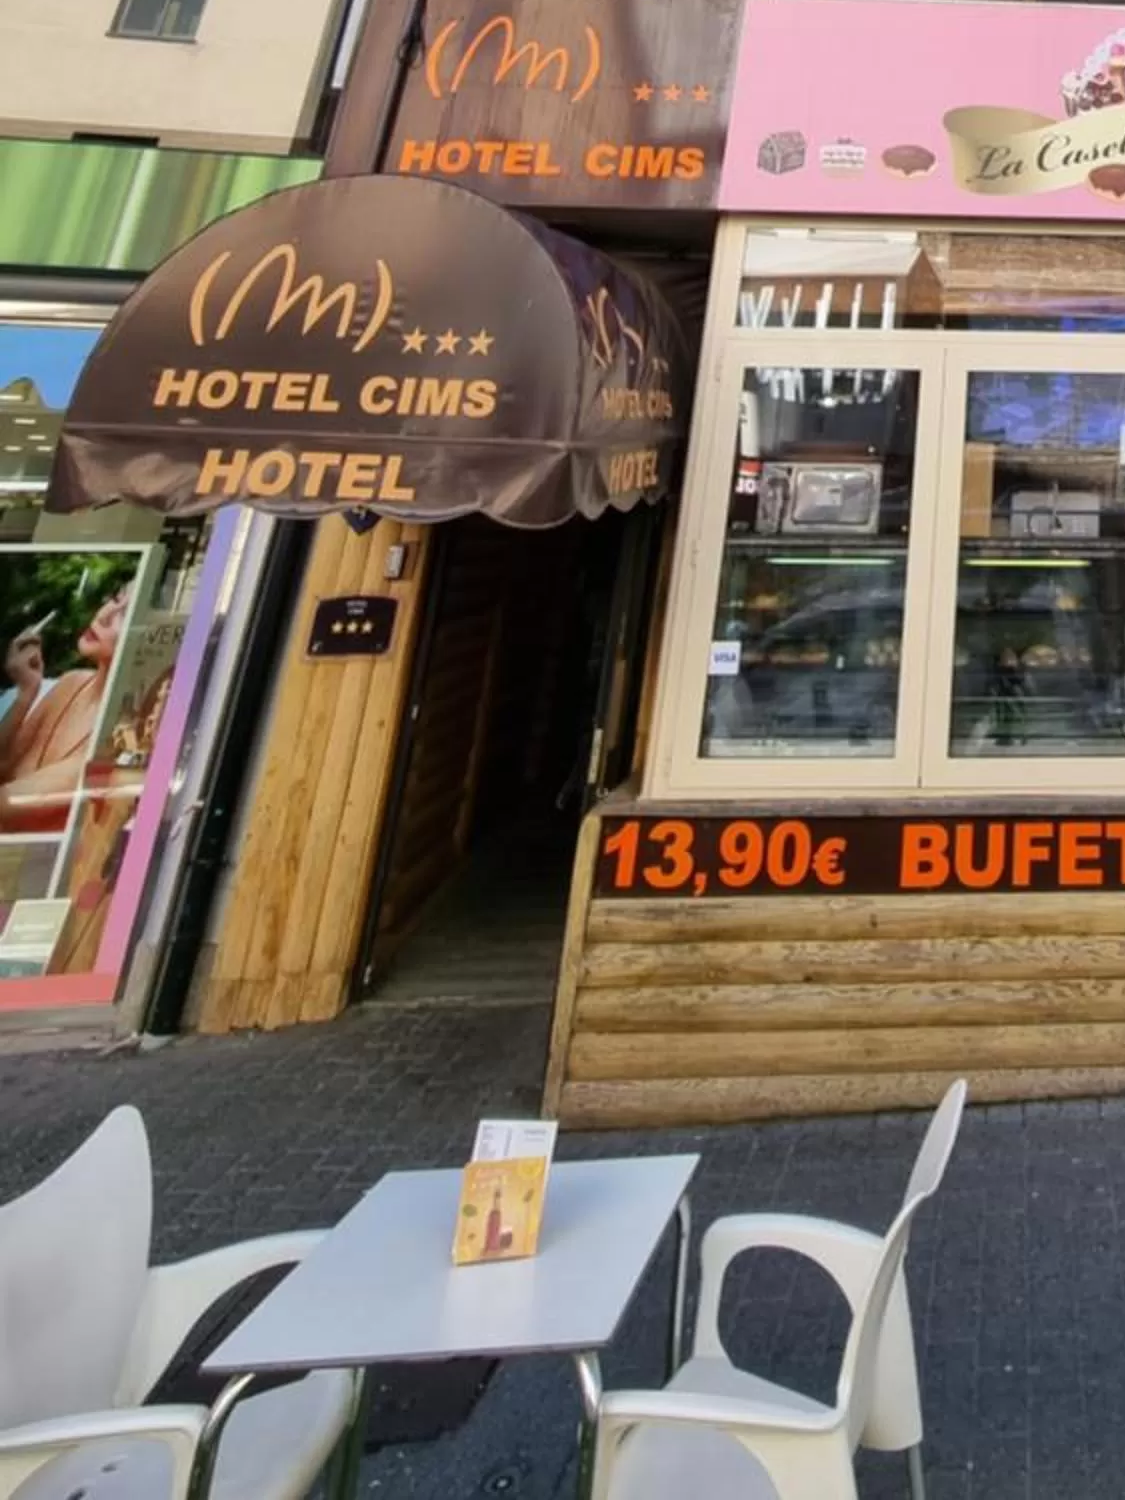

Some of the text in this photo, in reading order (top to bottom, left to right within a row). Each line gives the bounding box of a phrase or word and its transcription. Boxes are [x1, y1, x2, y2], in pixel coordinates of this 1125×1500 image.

[399, 140, 706, 180] HOTEL CIMS
[965, 144, 1025, 185] La
[153, 368, 498, 418] HOTEL CIMS
[195, 448, 415, 500] HOTEL
[609, 451, 657, 492] HOTEL
[603, 819, 847, 898] 13,90€
